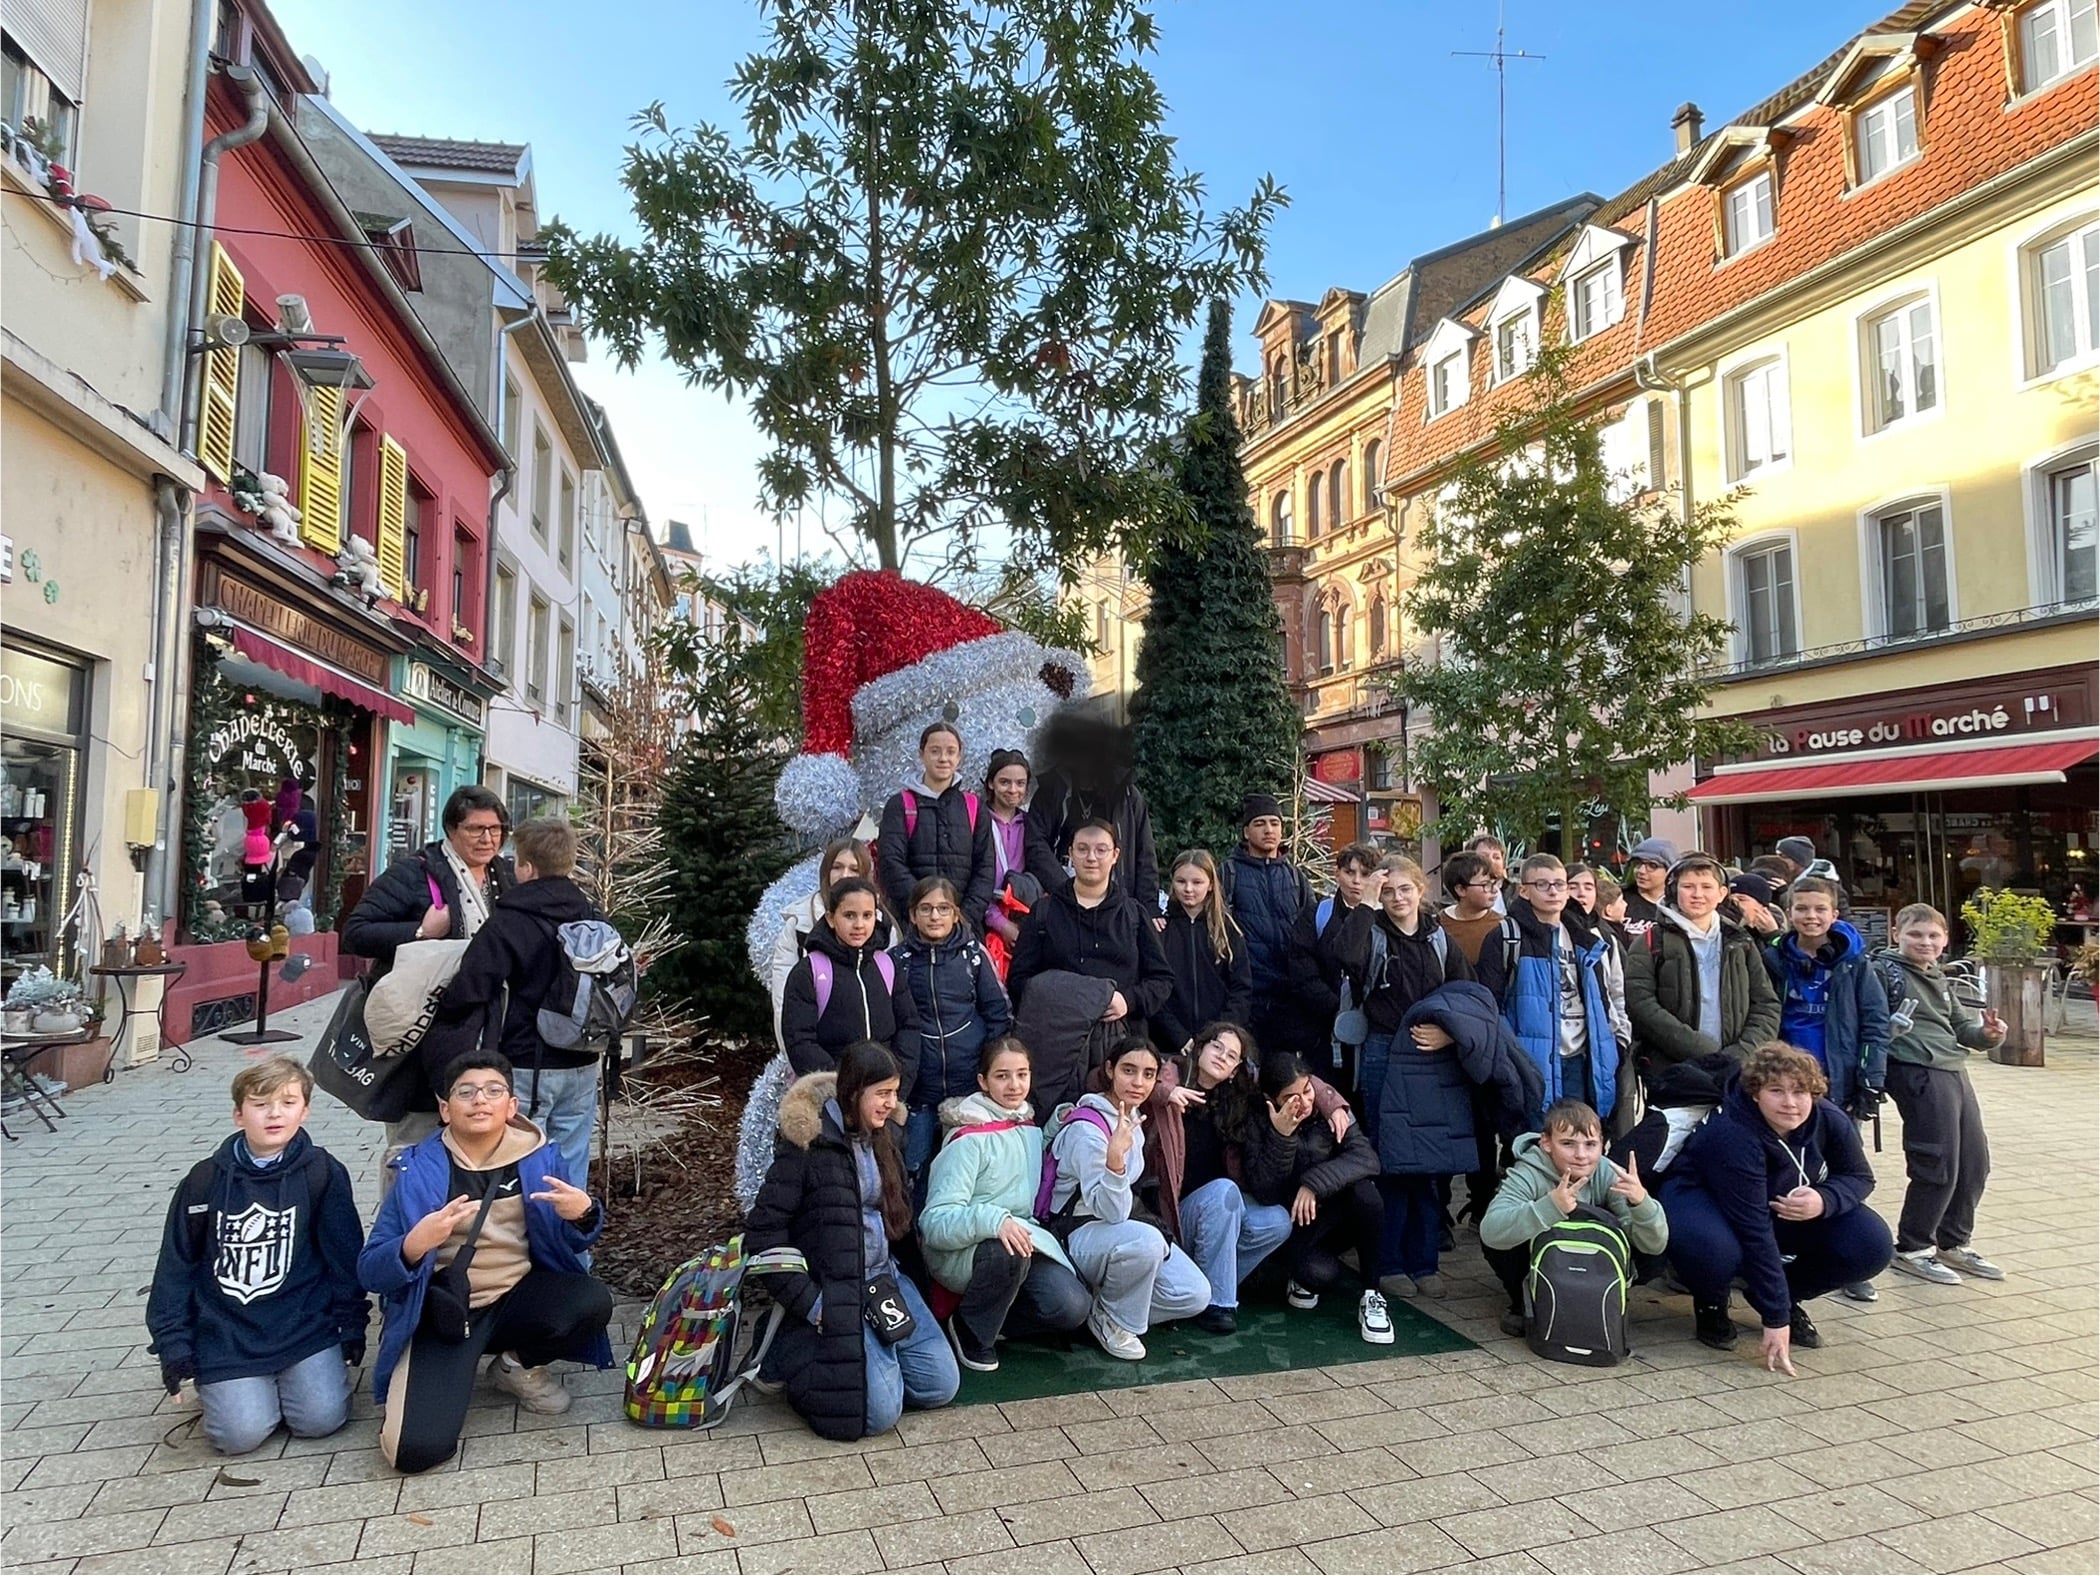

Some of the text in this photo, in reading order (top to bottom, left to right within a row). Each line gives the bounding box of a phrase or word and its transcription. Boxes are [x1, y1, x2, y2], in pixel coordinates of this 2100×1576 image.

[1793, 726, 1864, 752] Pause
[1868, 721, 1899, 743] du
[1903, 705, 2010, 738] Marché
[242, 750, 277, 774] Marché
[255, 738, 267, 755] du
[217, 1245, 281, 1287] NFL
